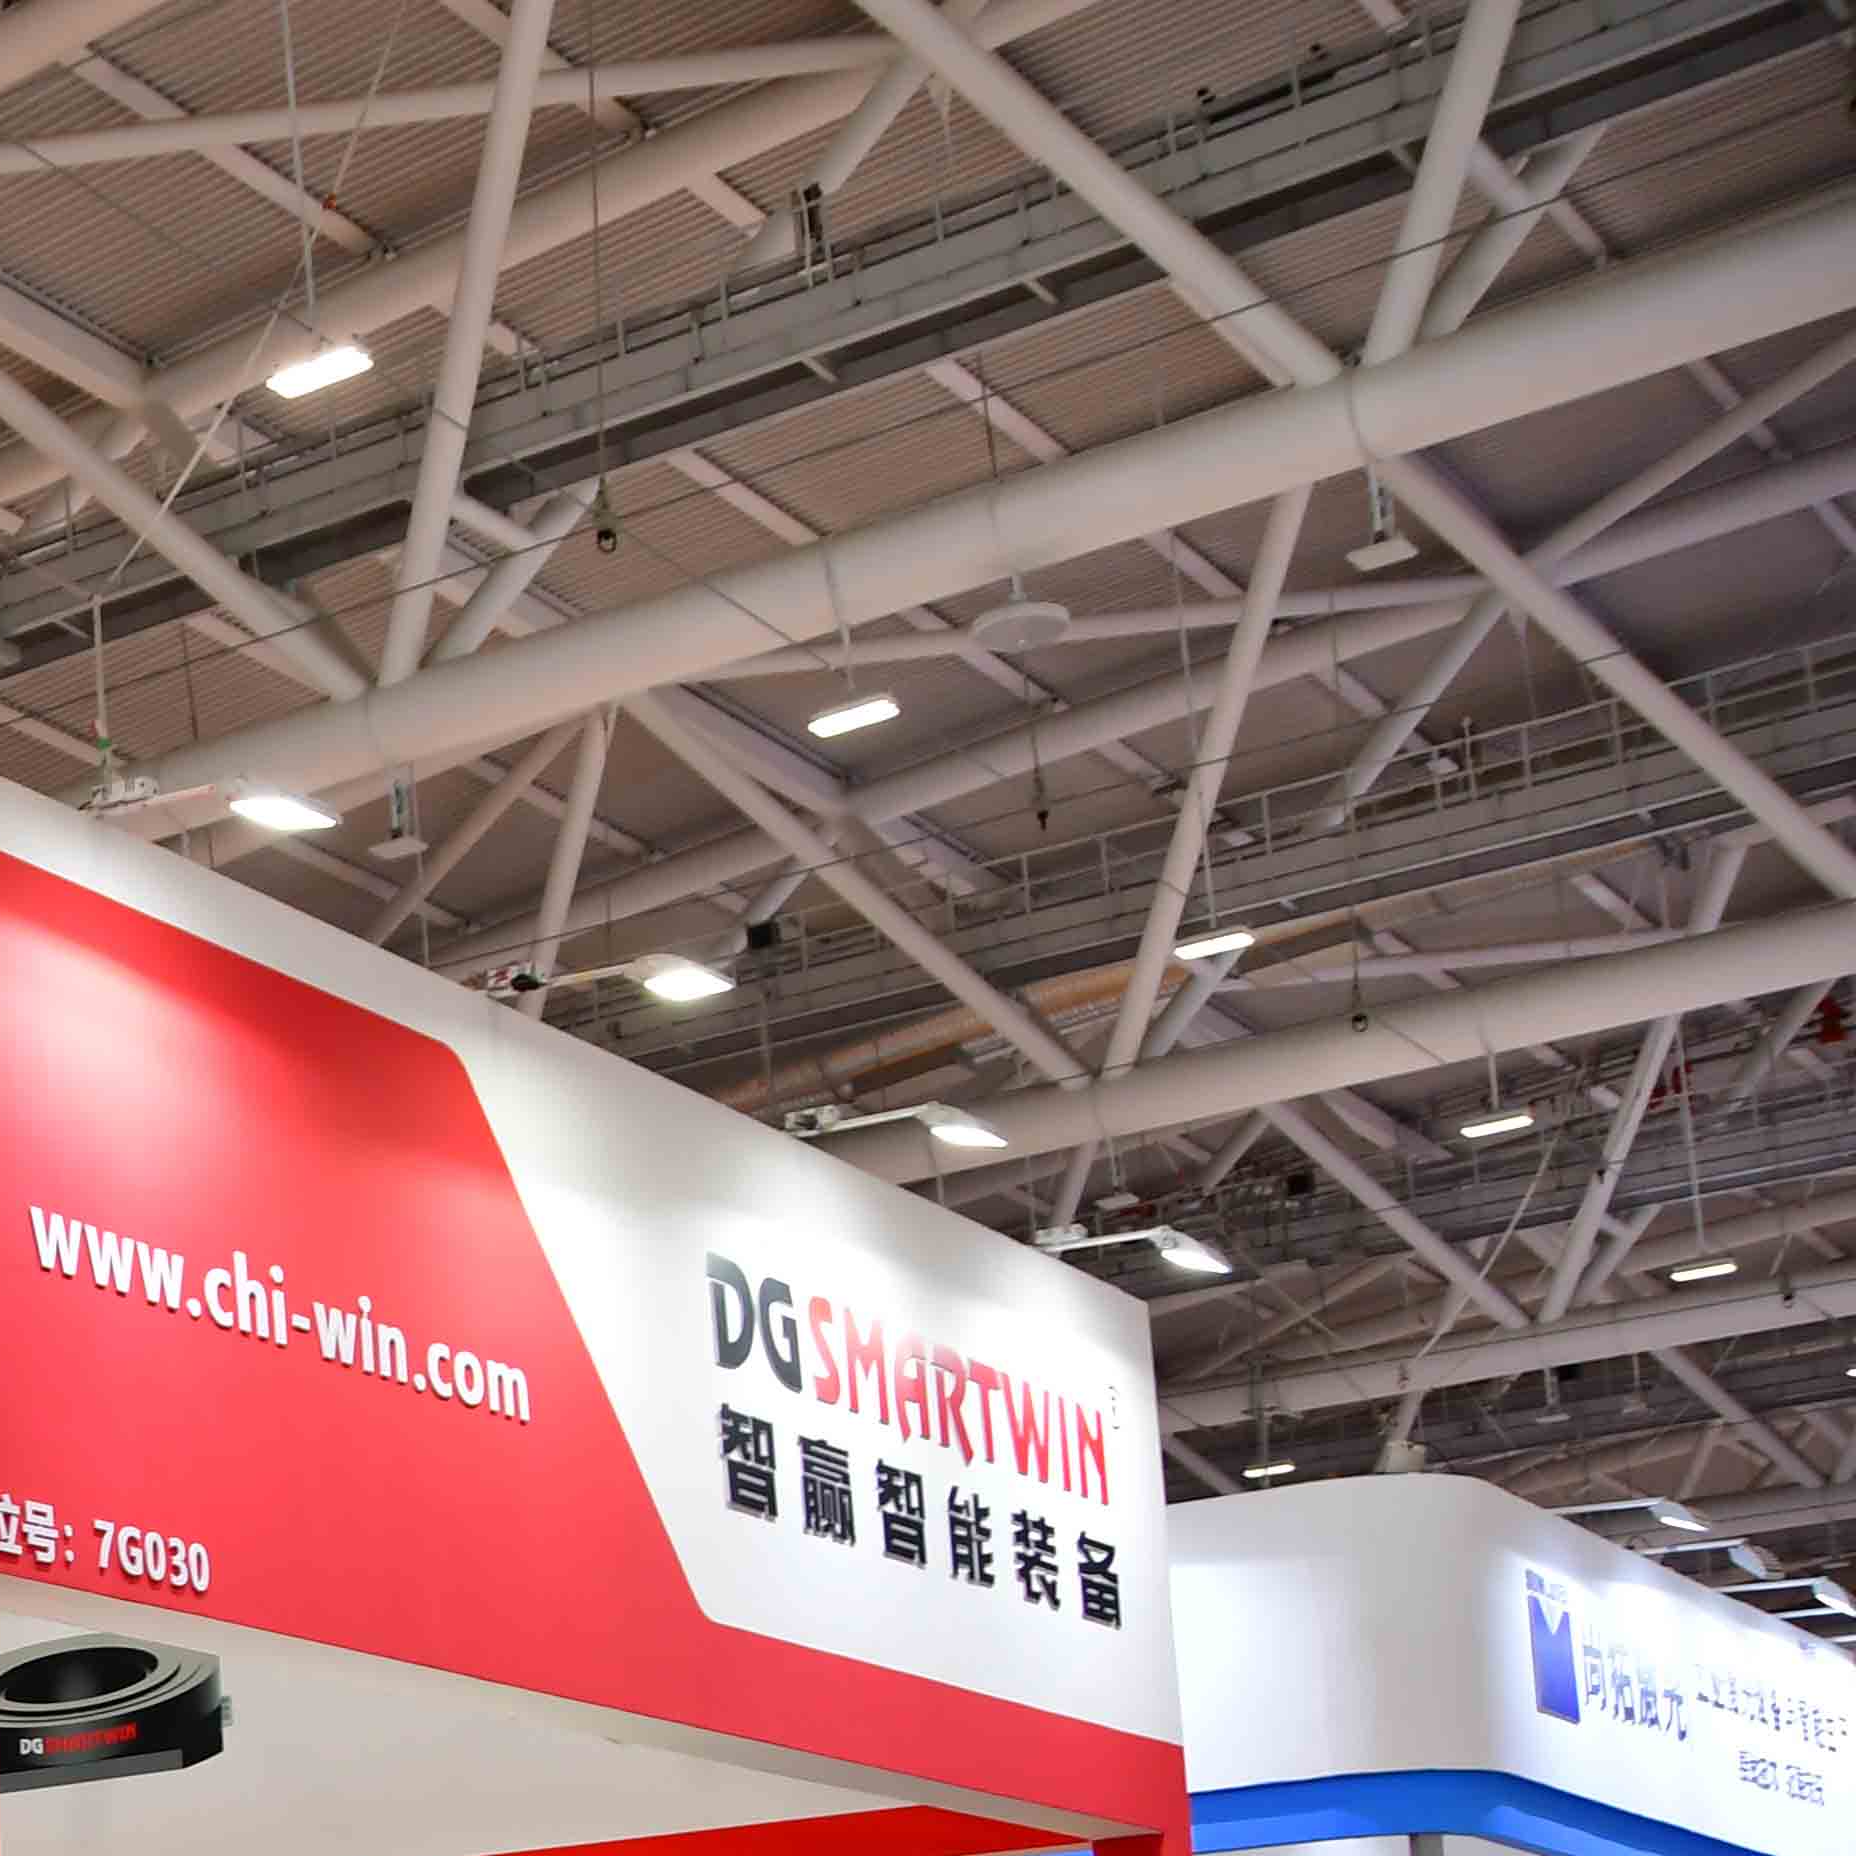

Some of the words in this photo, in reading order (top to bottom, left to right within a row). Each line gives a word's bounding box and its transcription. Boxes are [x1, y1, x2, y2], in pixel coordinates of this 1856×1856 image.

[30, 1204, 532, 1426] www.chi-win.com
[705, 1249, 1111, 1507] DGSMARTWIN
[718, 1403, 1122, 1630] 智赢智能装备
